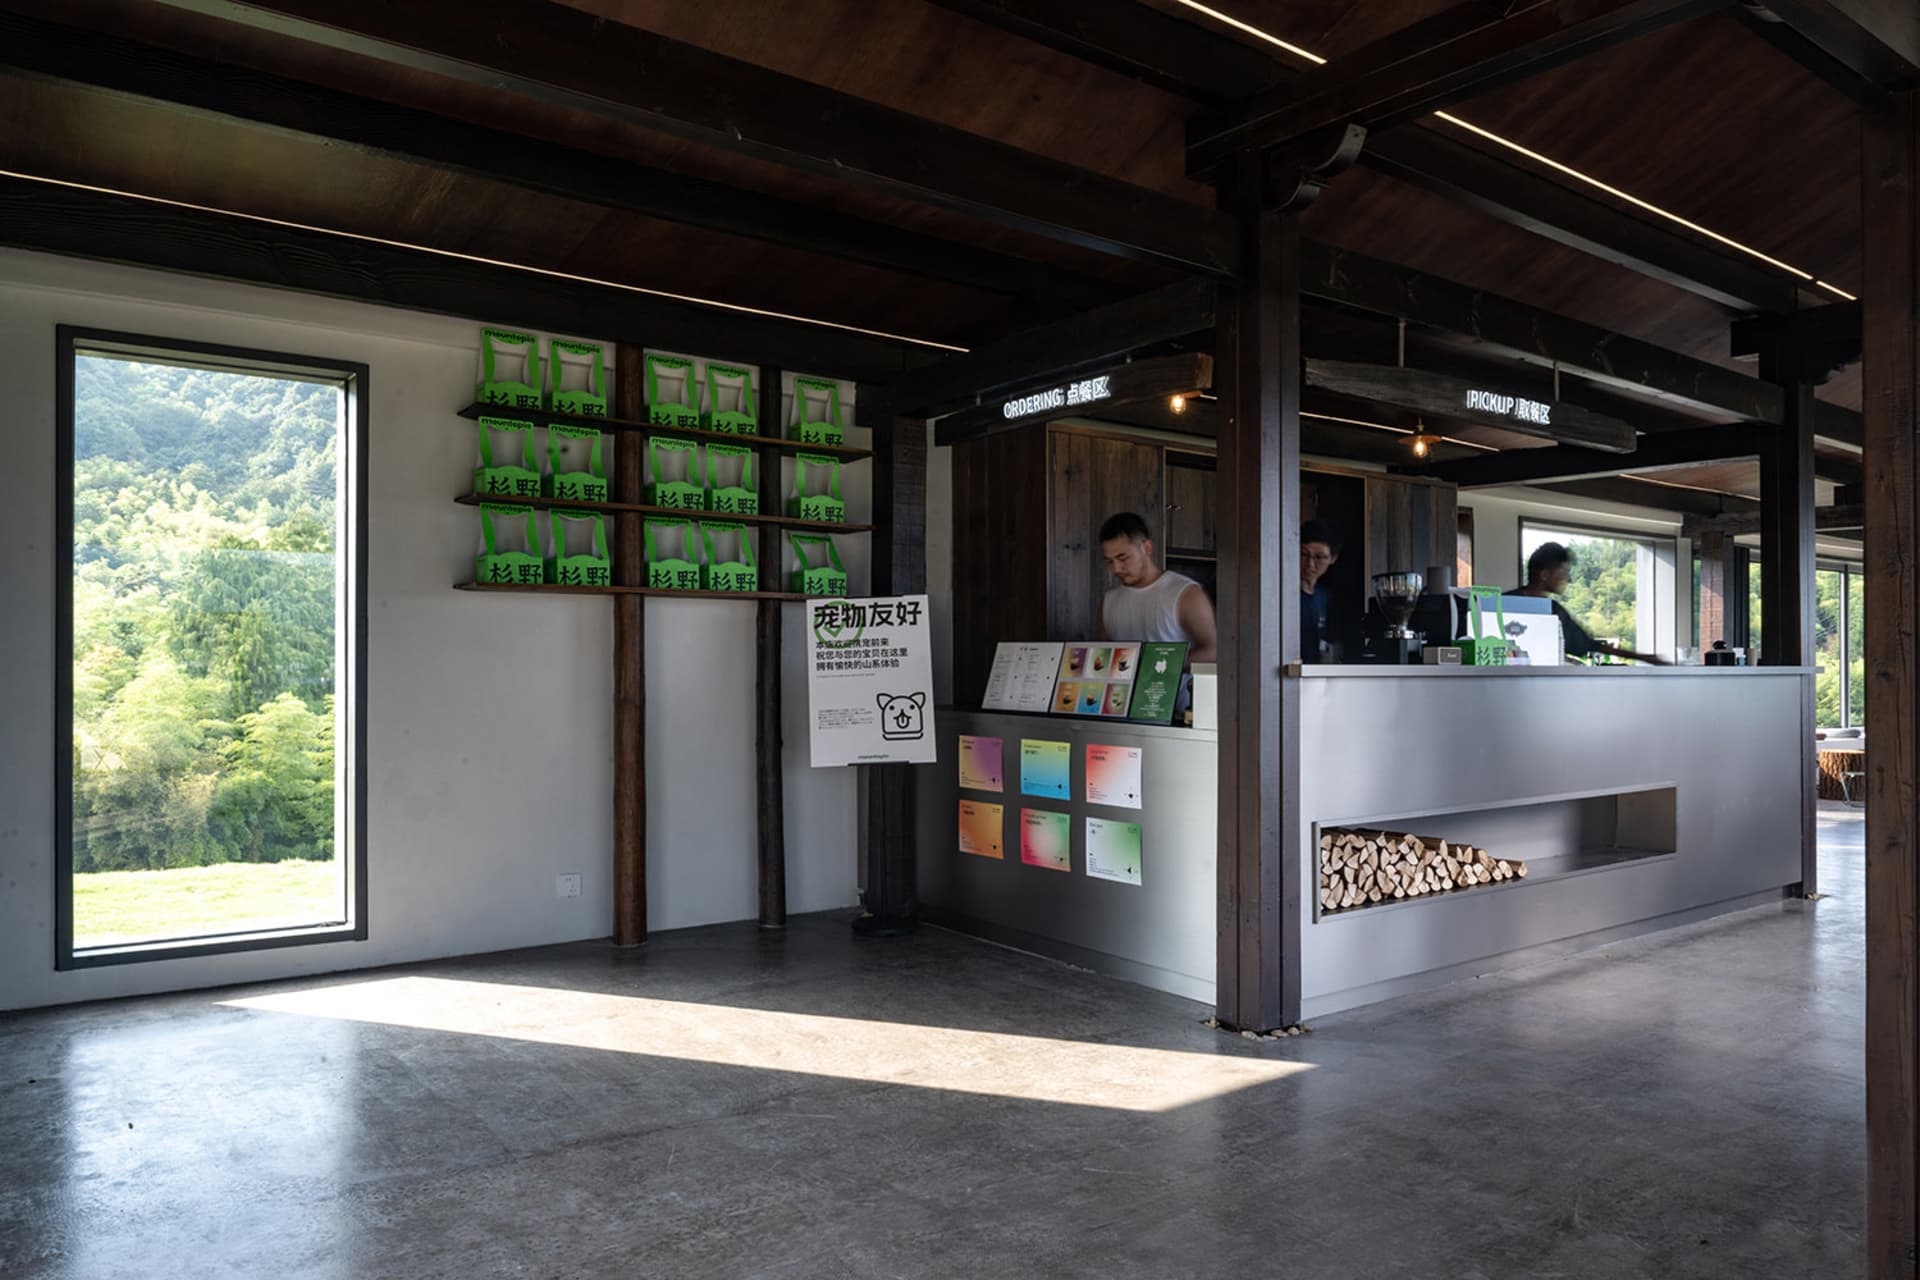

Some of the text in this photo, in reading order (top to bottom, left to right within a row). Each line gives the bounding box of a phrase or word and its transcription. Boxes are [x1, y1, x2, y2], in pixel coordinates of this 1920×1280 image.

[487, 390, 540, 409] 杉野
[1003, 376, 1111, 419] ORDERING 点餐区
[554, 400, 605, 417] 杉野
[1467, 390, 1551, 425] PICKUP 取餐区
[652, 412, 697, 428] 杉野
[714, 420, 756, 434] 杉野
[803, 430, 843, 446] 杉野
[488, 475, 540, 497] 杉野
[556, 481, 606, 501] 杉野
[659, 490, 704, 509] 杉野
[715, 496, 757, 514] 杉野
[803, 504, 844, 522] 杉野
[490, 563, 542, 584] 杉野
[559, 566, 609, 586] 杉野
[652, 569, 698, 590] 杉野
[712, 572, 756, 592] 杉野
[806, 577, 846, 596] 杉野
[814, 601, 922, 629] 宠物友好
[816, 647, 908, 660] 祝您与您的宝贝在这里
[1477, 646, 1507, 665] 杉野
